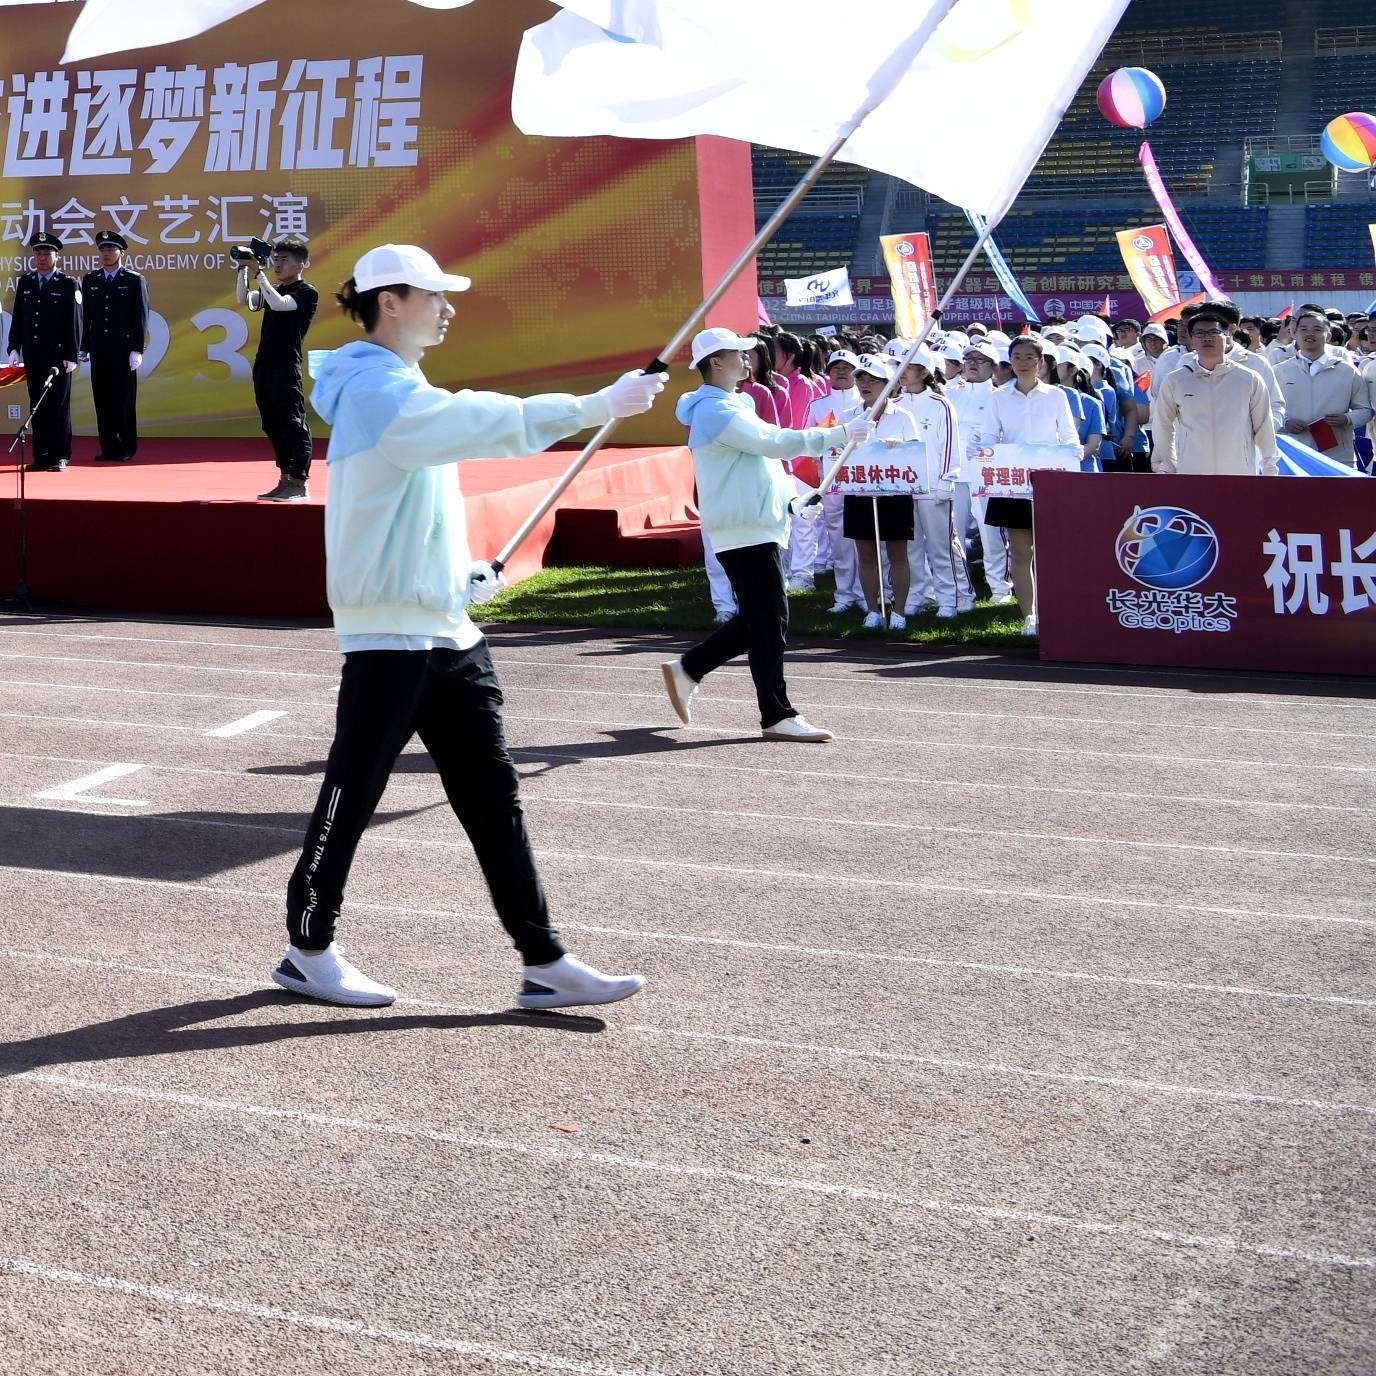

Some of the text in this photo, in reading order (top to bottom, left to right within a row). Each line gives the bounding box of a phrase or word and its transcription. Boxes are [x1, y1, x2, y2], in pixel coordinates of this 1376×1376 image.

[124, 254, 199, 270] ACADEMY
[203, 253, 225, 270] OF
[834, 464, 919, 485] 离退休中心
[1105, 588, 1238, 618] 长光华大
[1118, 609, 1232, 634] GeOptics
[308, 845, 325, 873] TIME
[307, 887, 319, 912] RUN
